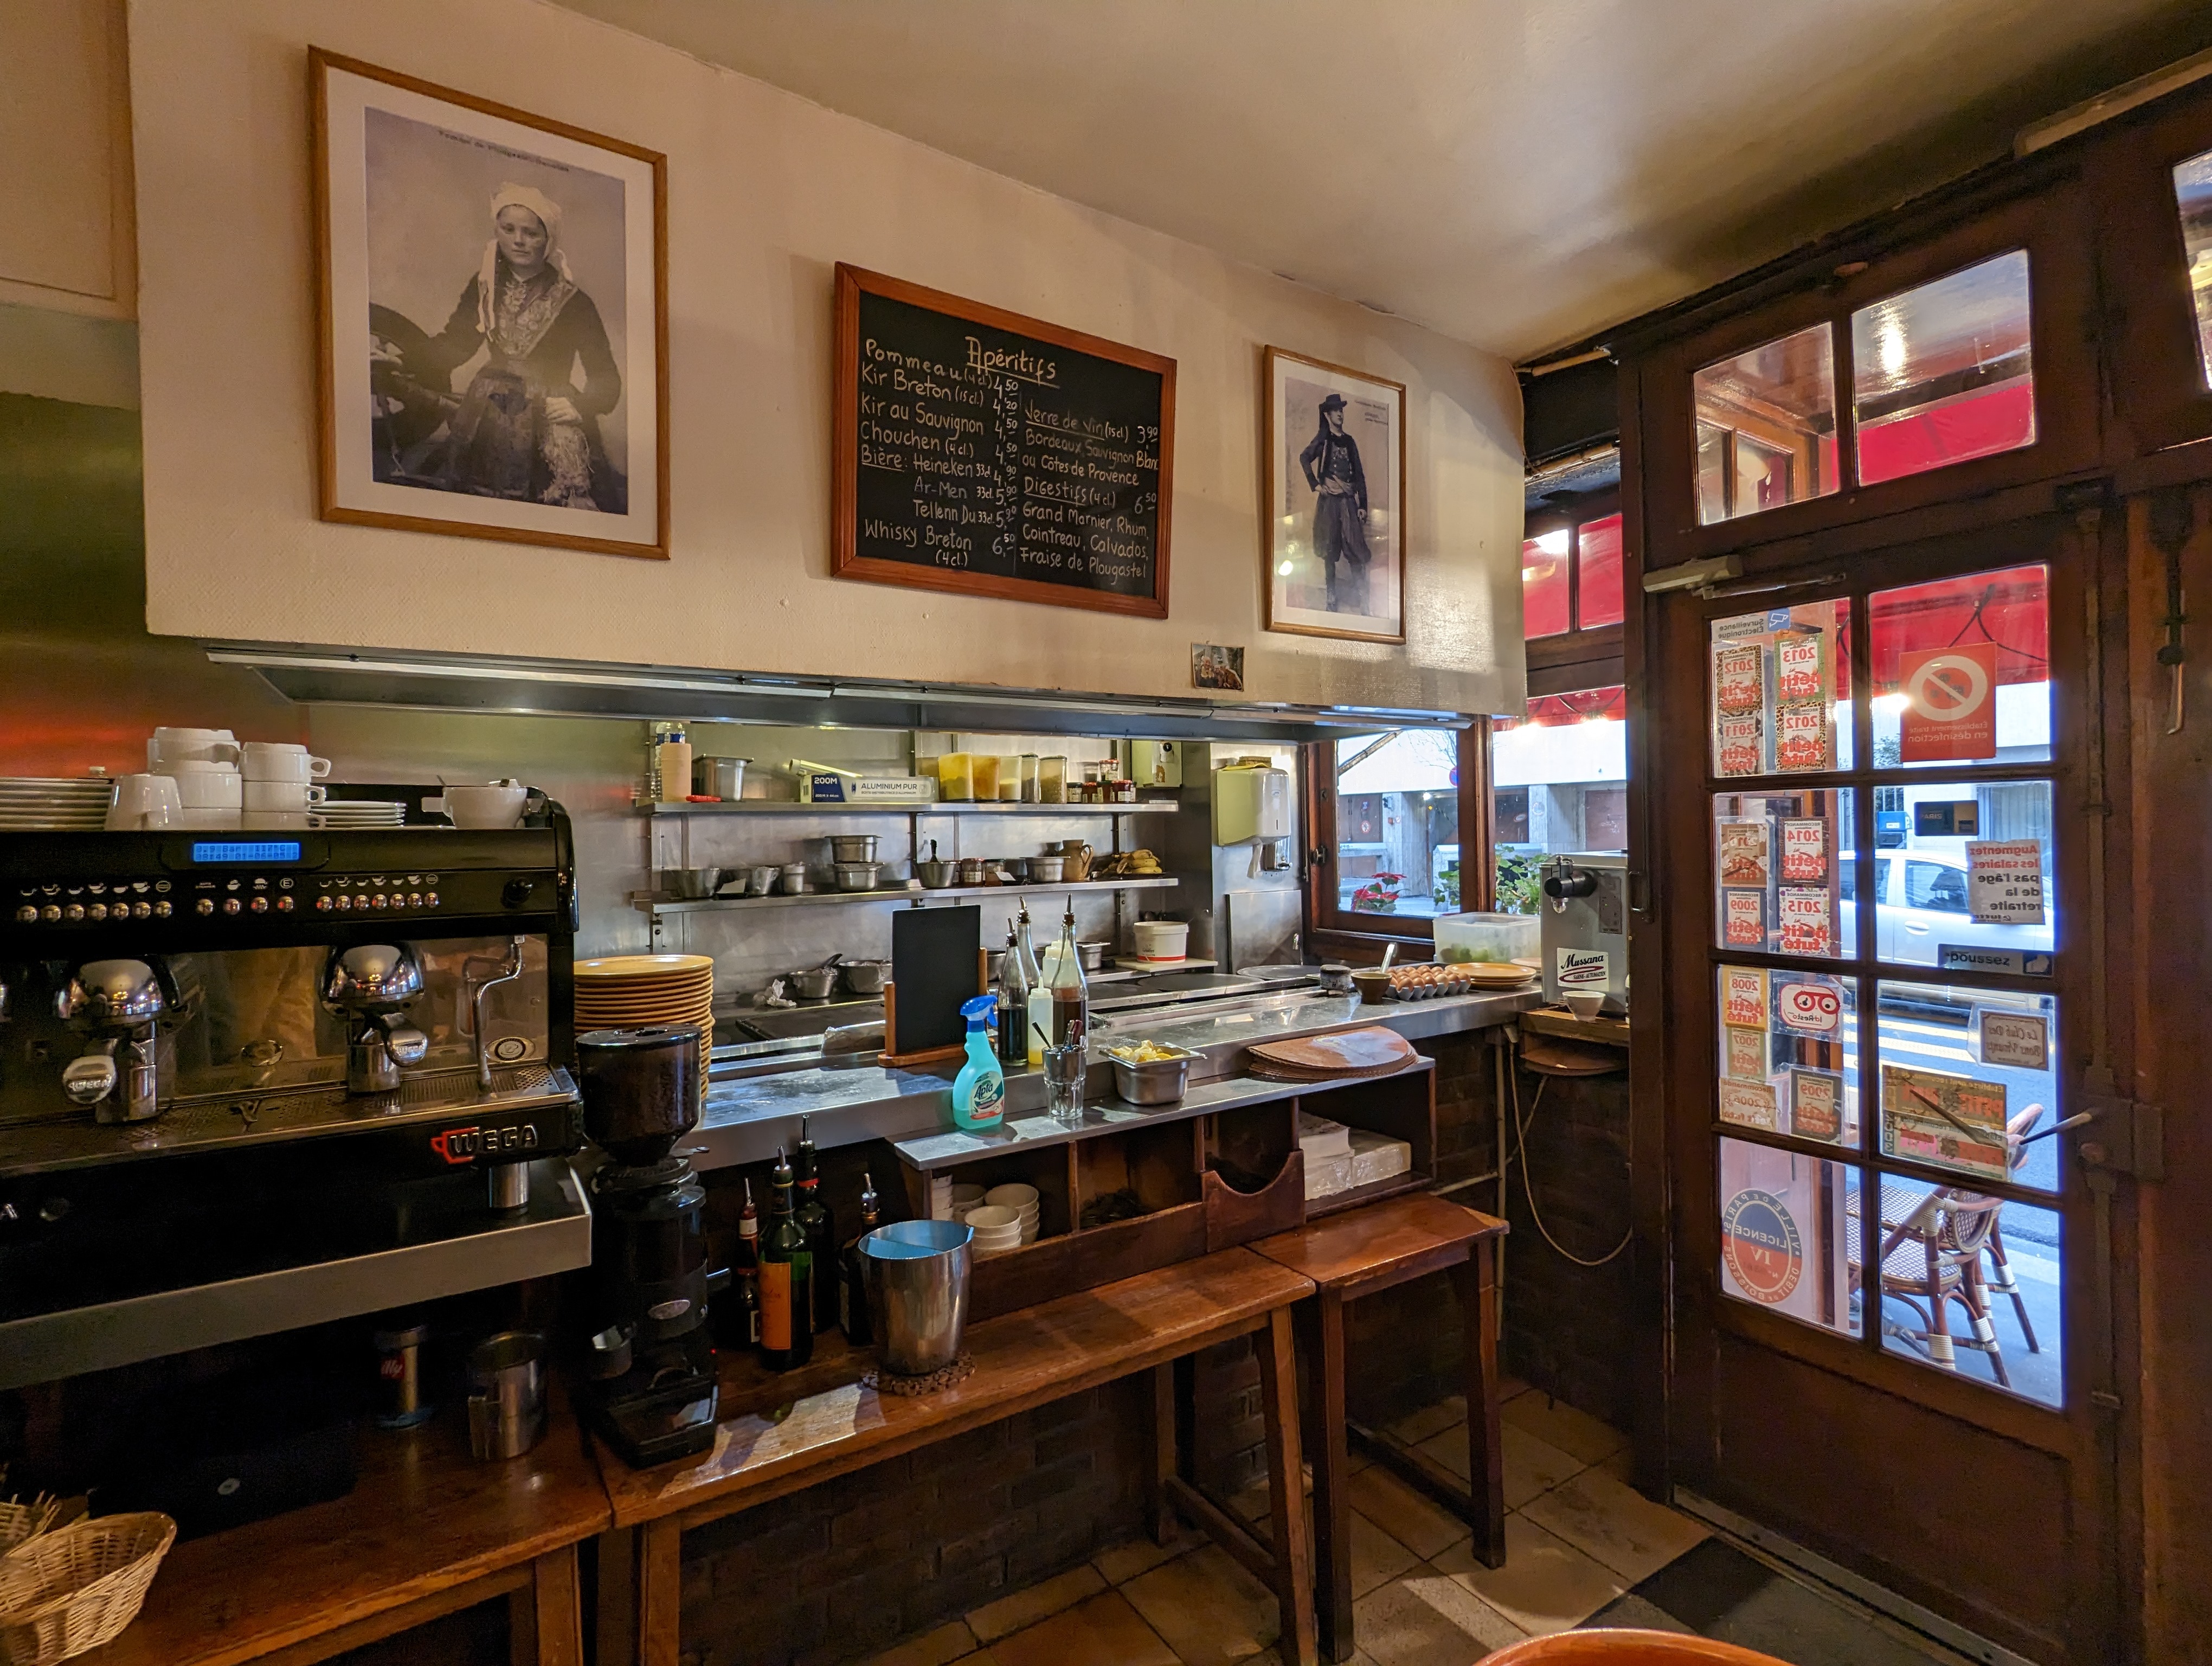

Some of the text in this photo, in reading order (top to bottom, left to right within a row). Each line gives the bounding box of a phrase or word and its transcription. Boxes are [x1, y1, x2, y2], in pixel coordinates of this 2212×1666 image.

[866, 338, 962, 381] Pommeau
[965, 336, 1057, 379] Apéritifs
[862, 361, 888, 385] Kir
[894, 369, 951, 401] Breton
[861, 392, 886, 416] Kir
[890, 404, 909, 420] au
[916, 402, 983, 441] Sauvignon
[1025, 399, 1059, 426] Verre
[1063, 409, 1078, 430] de
[1083, 417, 1103, 435] Vin
[861, 419, 940, 451] Chouchen
[1025, 428, 1081, 454] Bordeaux
[1085, 439, 1134, 470] Sauvignon
[913, 452, 973, 478] Heineken
[1022, 454, 1140, 486] ou Côtes de Provence
[914, 476, 967, 499] Ar-Men
[1024, 477, 1086, 507] Digestifs
[913, 498, 958, 522] Tellenn
[961, 504, 976, 525] Du
[1023, 501, 1063, 523] Grand
[864, 518, 918, 548] Whisky
[924, 524, 972, 552] Breton
[1019, 547, 1146, 585] Fraise de Plougastel
[814, 777, 838, 785] 200M
[1560, 953, 1604, 969] Mussana
[1950, 952, 2010, 967] poussez
[973, 1083, 993, 1100] Apta
[449, 1125, 538, 1154] WEGA
